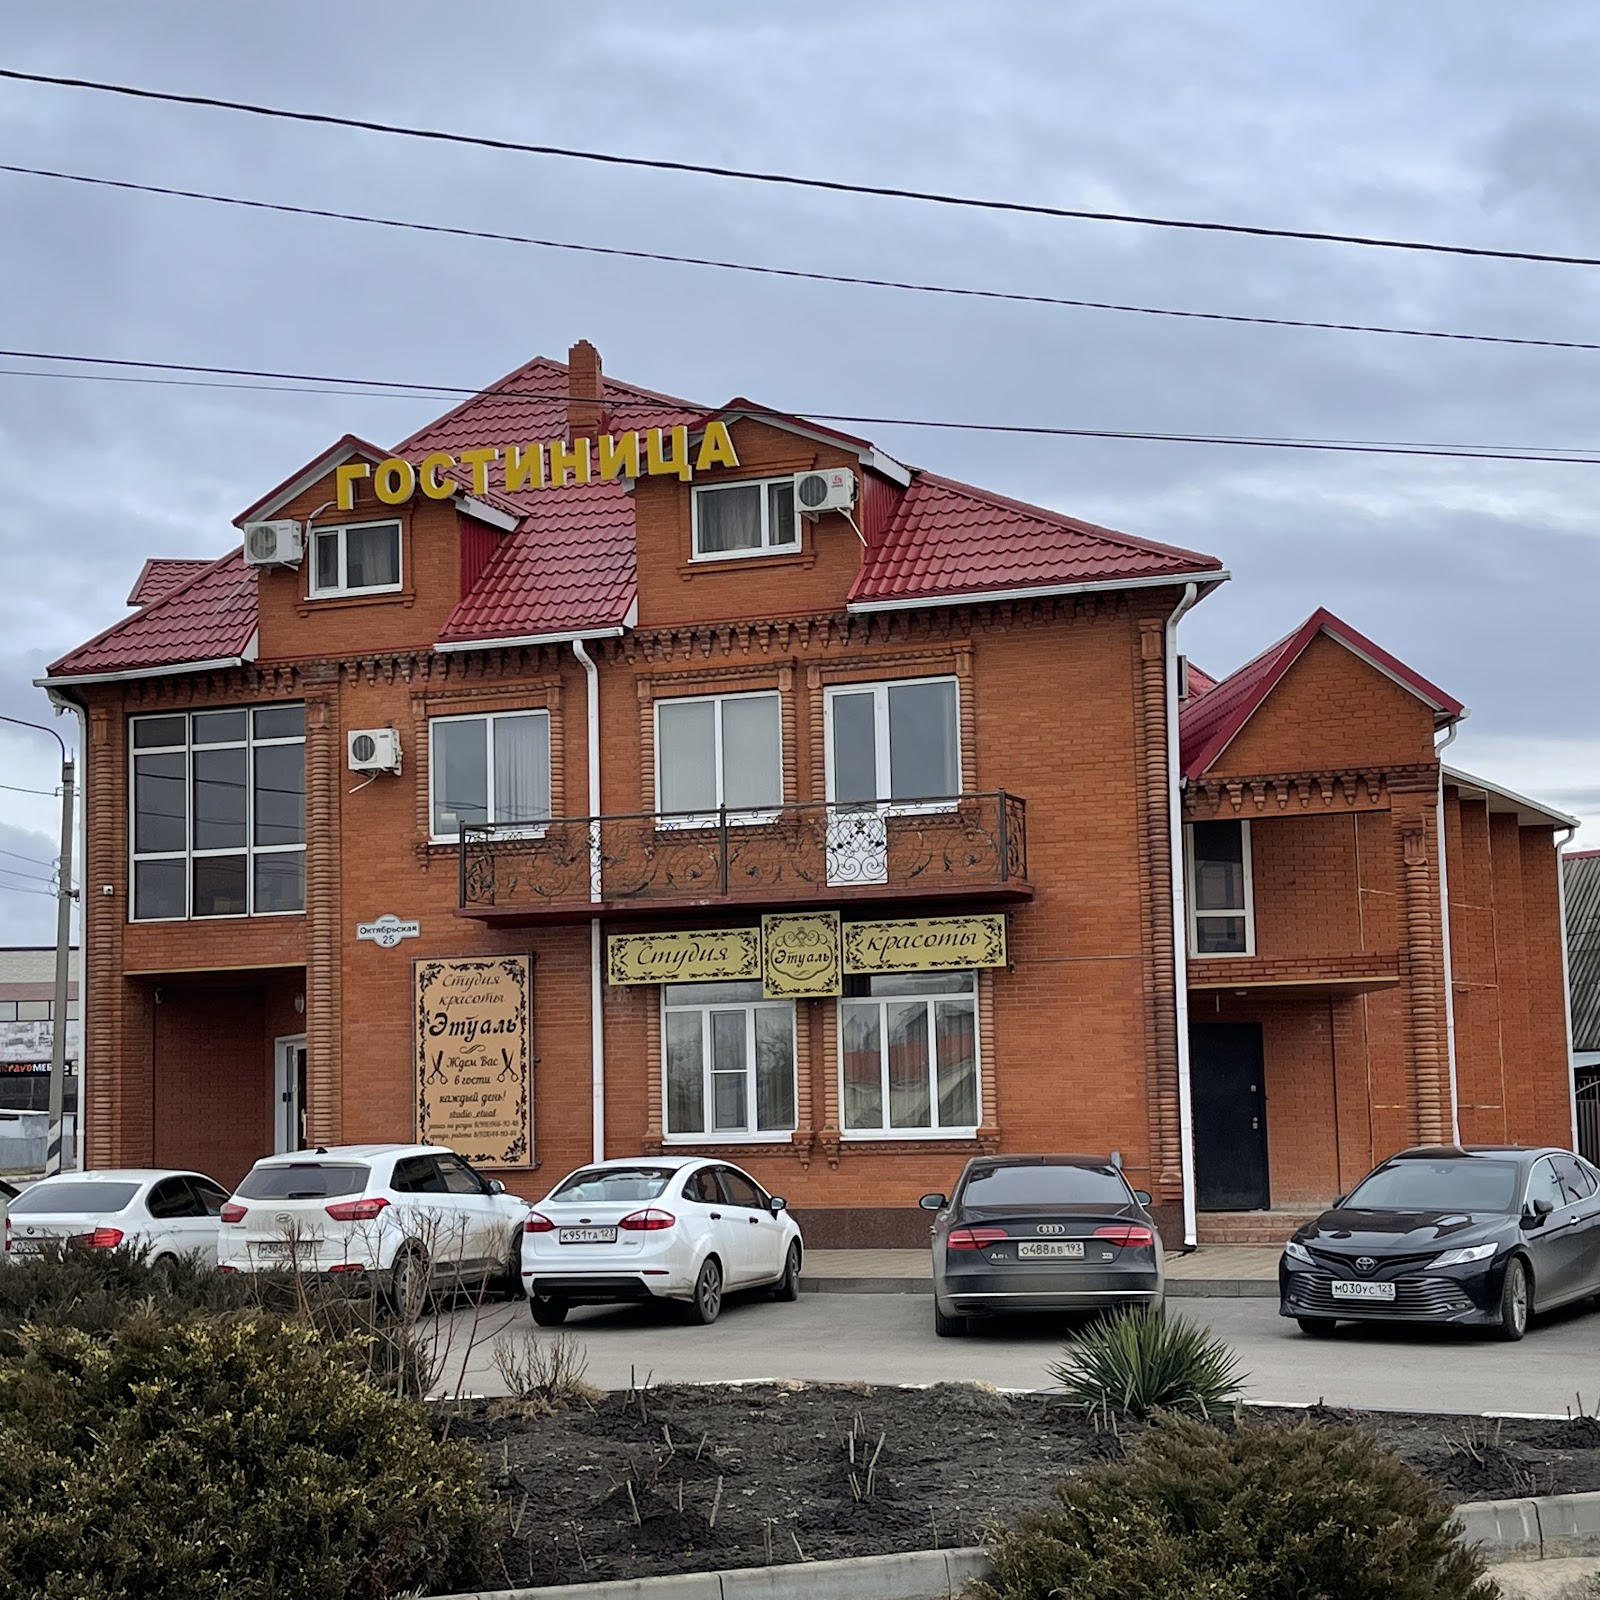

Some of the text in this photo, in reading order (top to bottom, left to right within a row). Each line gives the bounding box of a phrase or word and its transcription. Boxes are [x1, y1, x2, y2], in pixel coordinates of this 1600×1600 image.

[336, 421, 740, 510] ГОСТИНИЦА
[360, 925, 417, 935] Октябрьская
[383, 935, 395, 944] 25
[867, 931, 981, 962] красоты
[637, 942, 732, 973] Студия
[774, 950, 830, 968] Этуаль
[442, 972, 500, 993] Студия
[439, 992, 504, 1011] красоты
[429, 1012, 516, 1042] Этуаль
[446, 1055, 499, 1072] Ждем Вас
[454, 1075, 491, 1085] в гости
[439, 1090, 506, 1107] каждый день!
